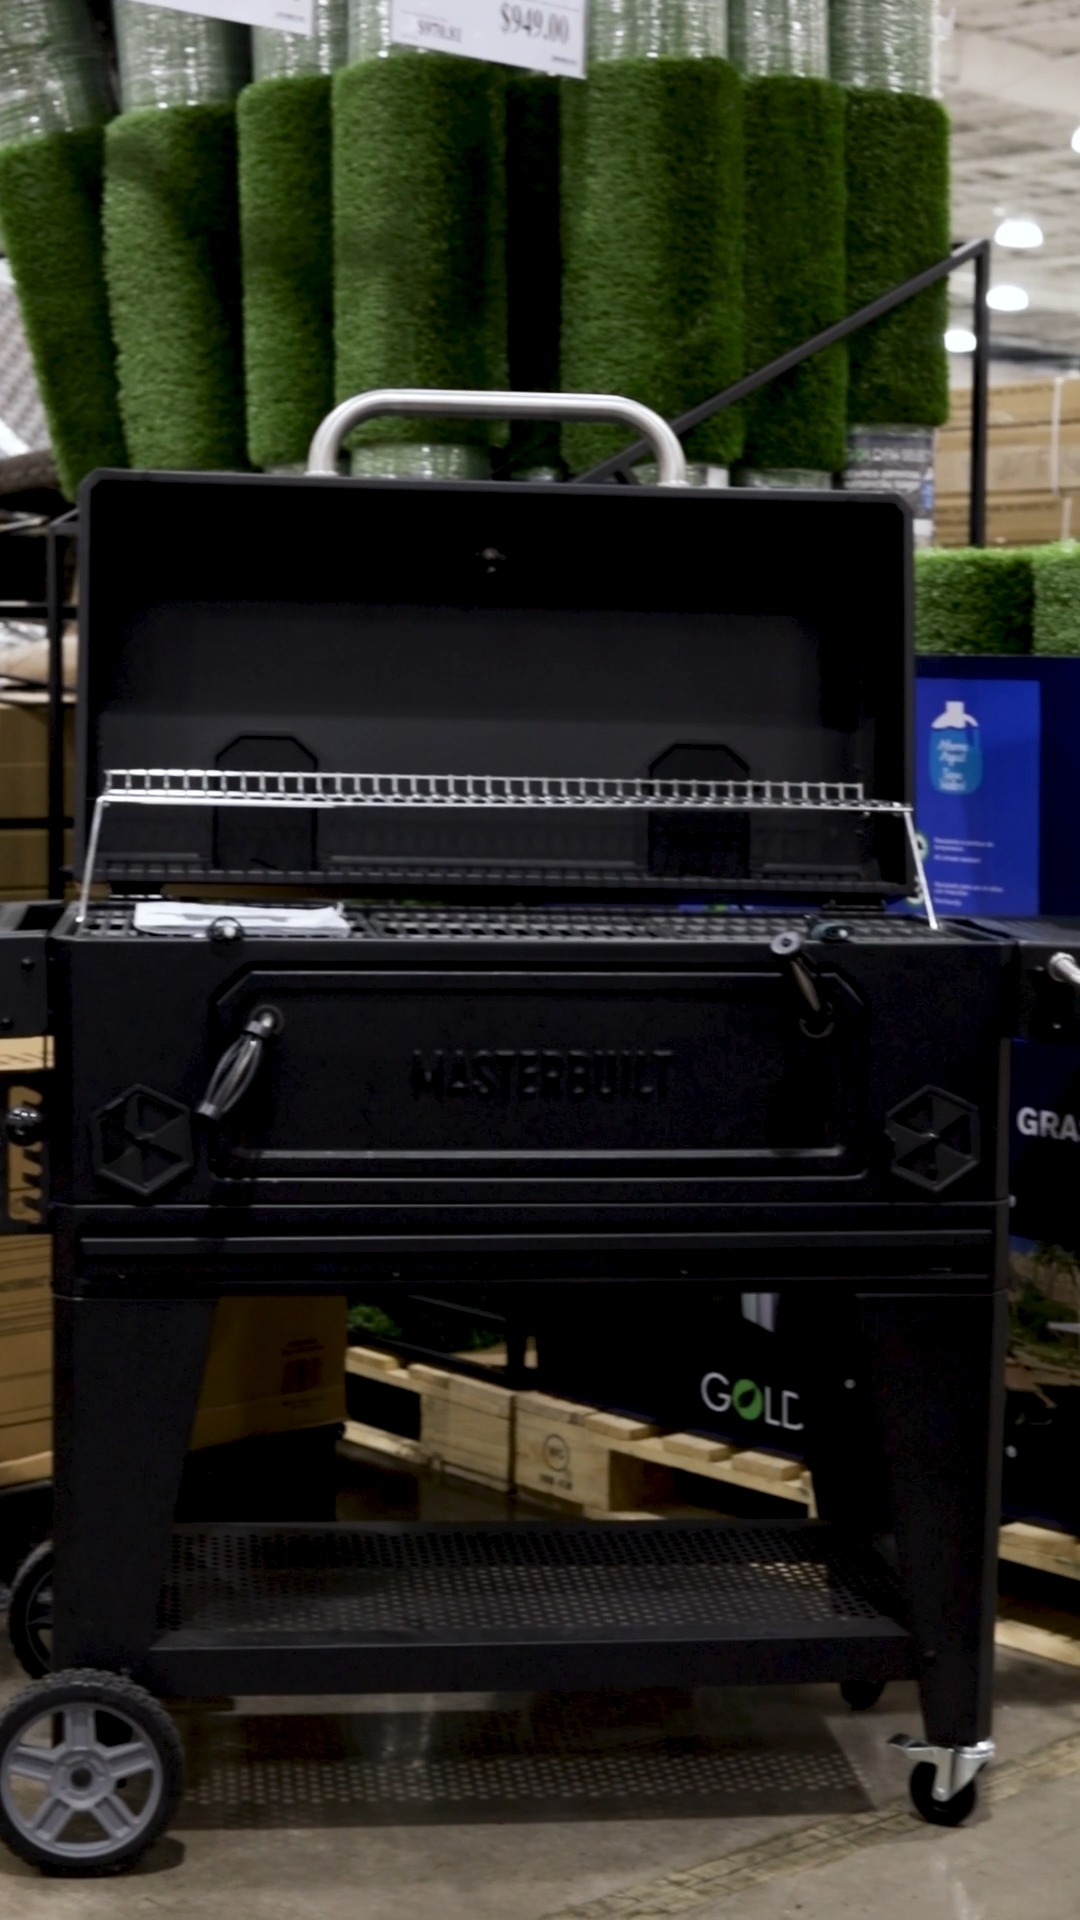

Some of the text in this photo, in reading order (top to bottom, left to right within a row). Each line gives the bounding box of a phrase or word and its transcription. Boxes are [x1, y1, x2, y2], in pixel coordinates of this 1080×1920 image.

[501, 2, 569, 44] $949.00
[411, 1049, 675, 1099] MASTERBUILT
[1016, 1106, 1080, 1142] GRA
